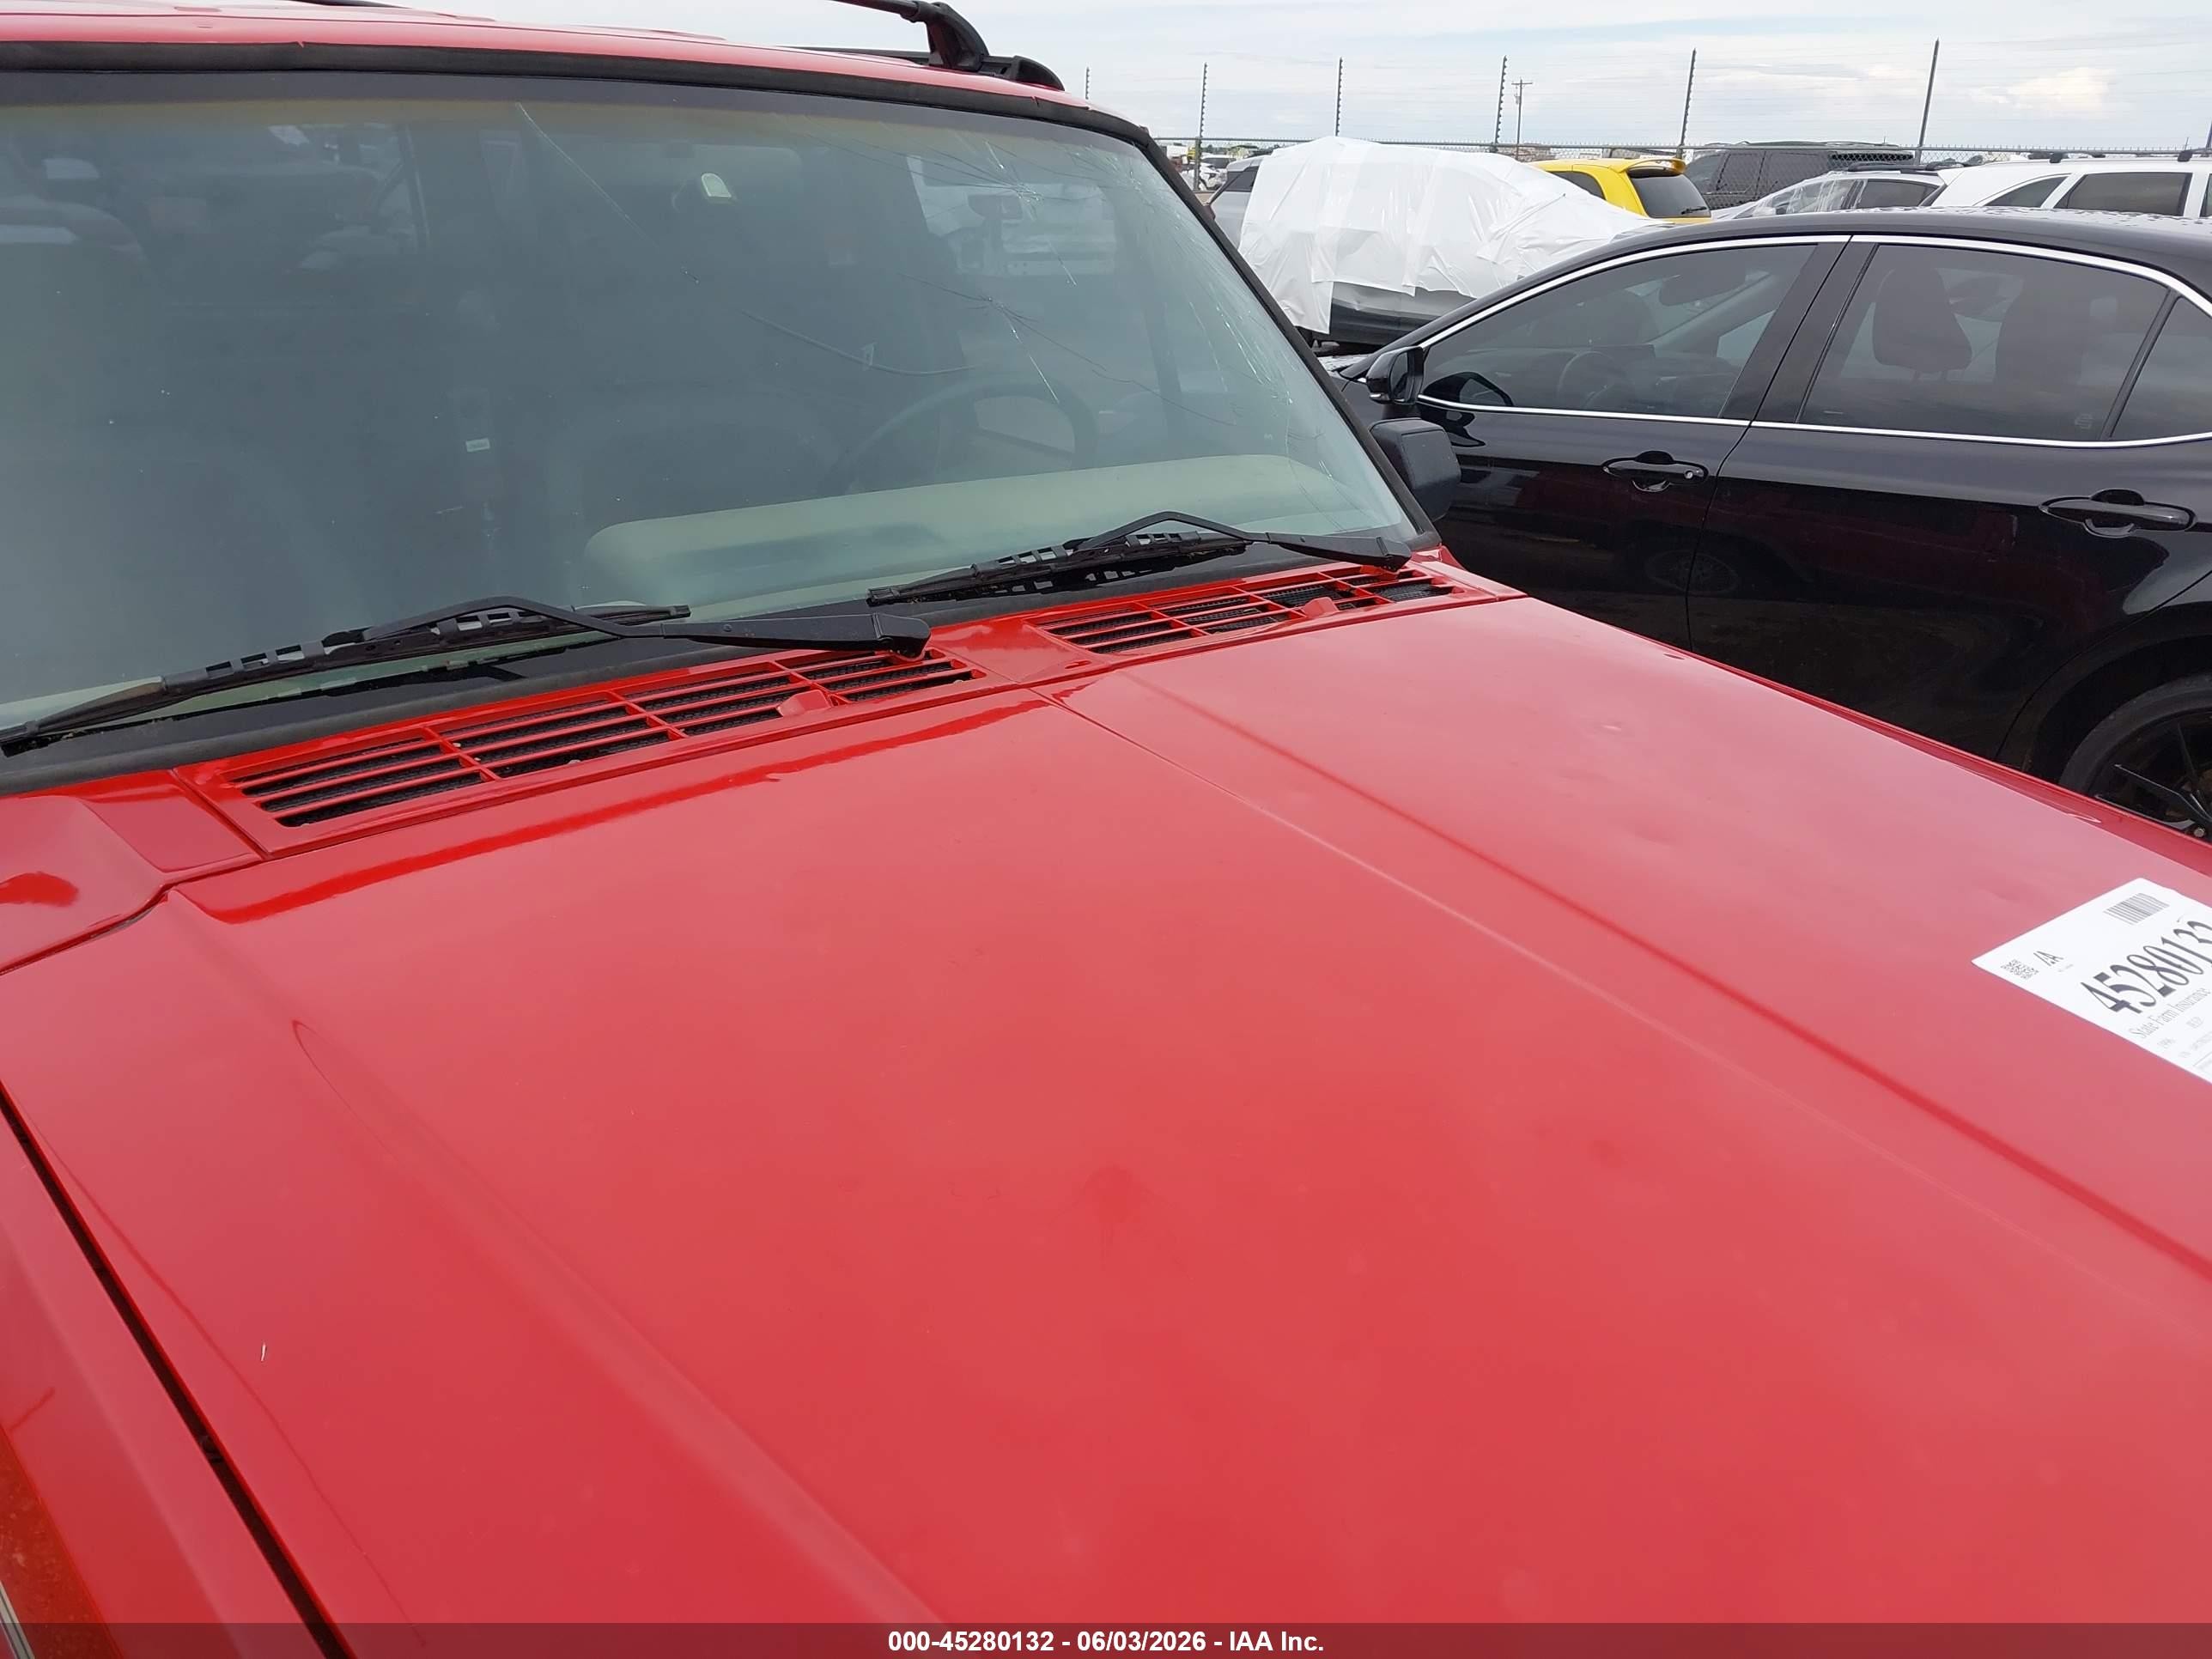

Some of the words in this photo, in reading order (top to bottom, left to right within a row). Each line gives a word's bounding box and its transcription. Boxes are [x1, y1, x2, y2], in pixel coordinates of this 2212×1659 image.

[2129, 1023, 2160, 1039] State
[2148, 1009, 2179, 1026] Farm
[2166, 987, 2212, 1012] Insurance
